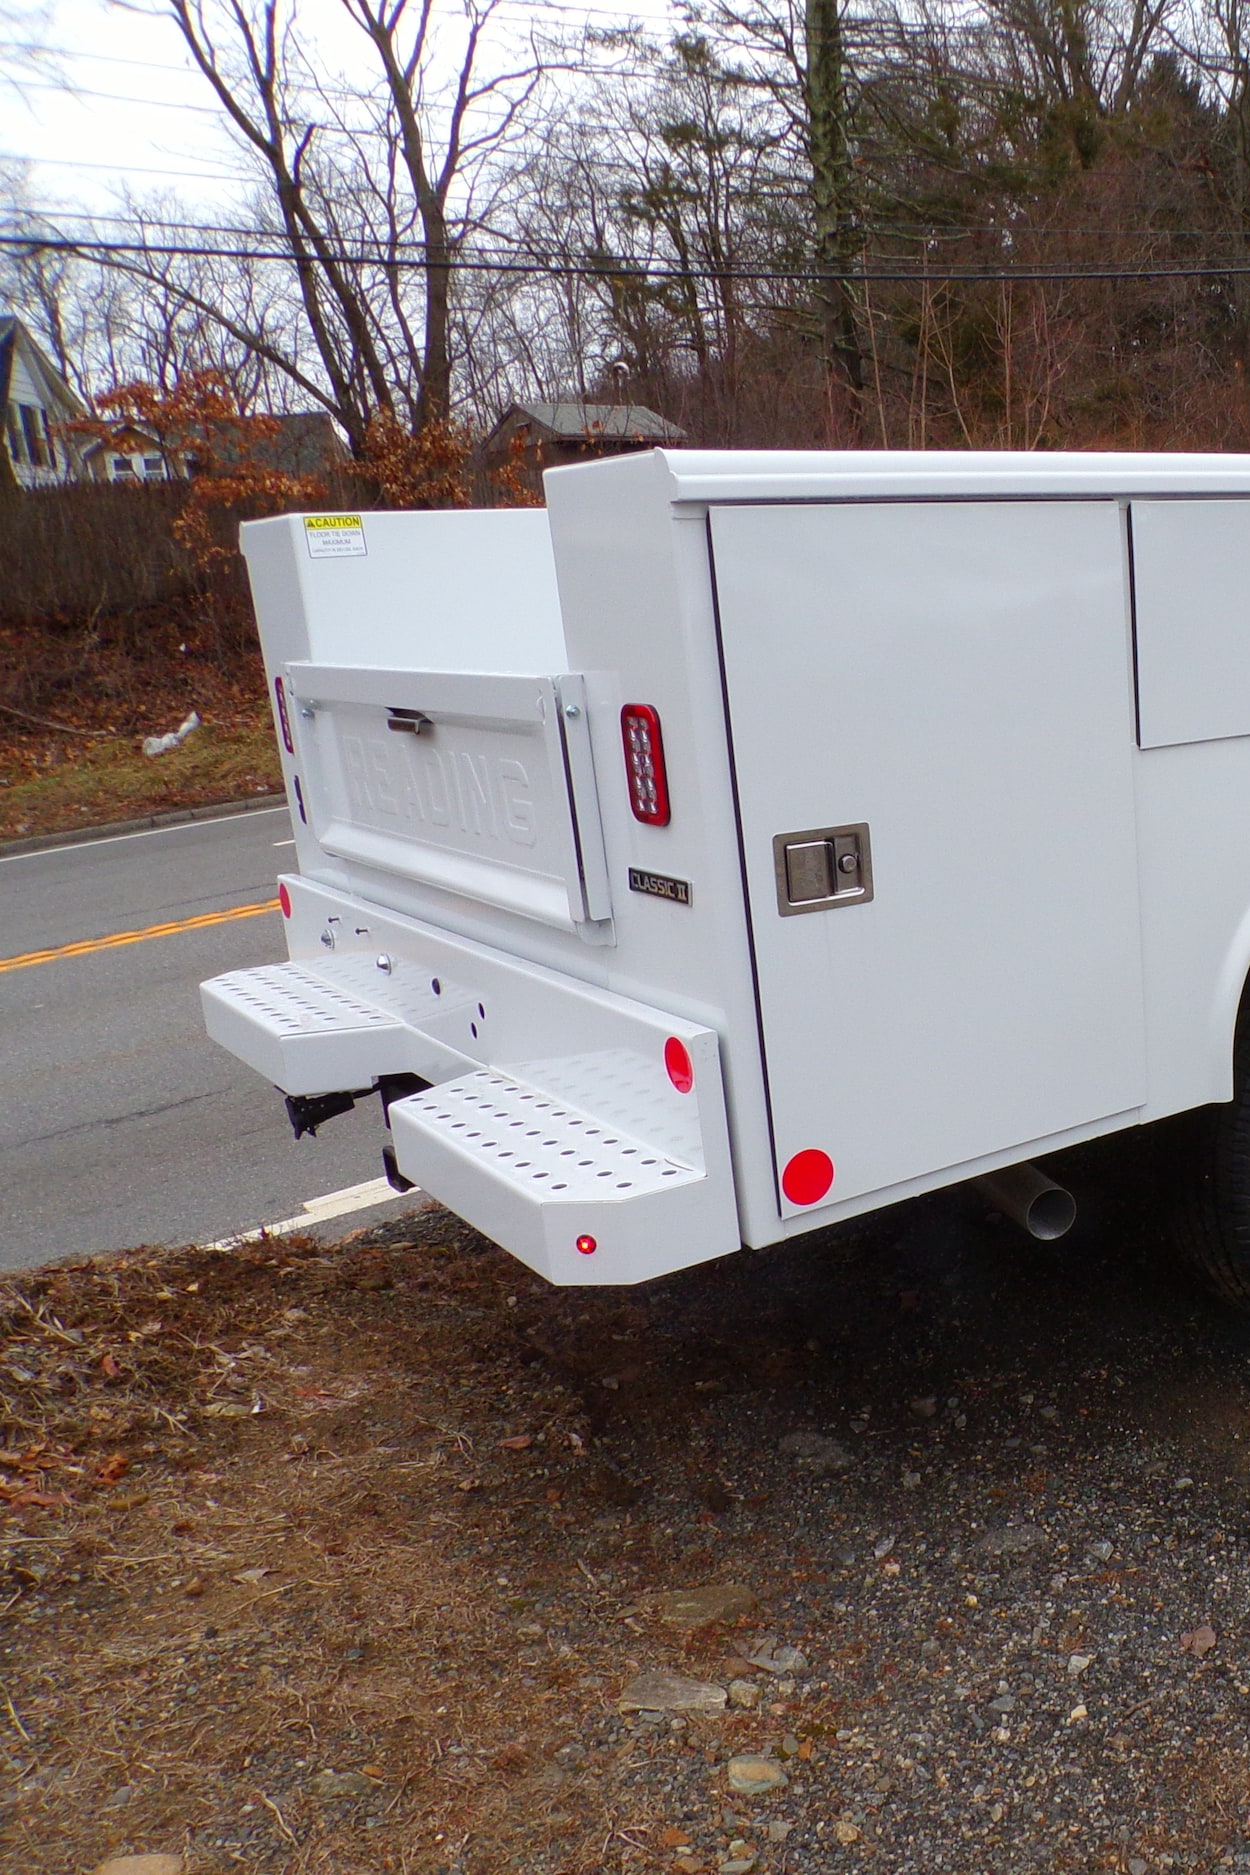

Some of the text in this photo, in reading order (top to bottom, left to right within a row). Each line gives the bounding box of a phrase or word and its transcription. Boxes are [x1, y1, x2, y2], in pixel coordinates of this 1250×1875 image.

[315, 517, 360, 527] CAUTION
[341, 735, 537, 849] READING
[631, 872, 687, 900] CLASSIC II
